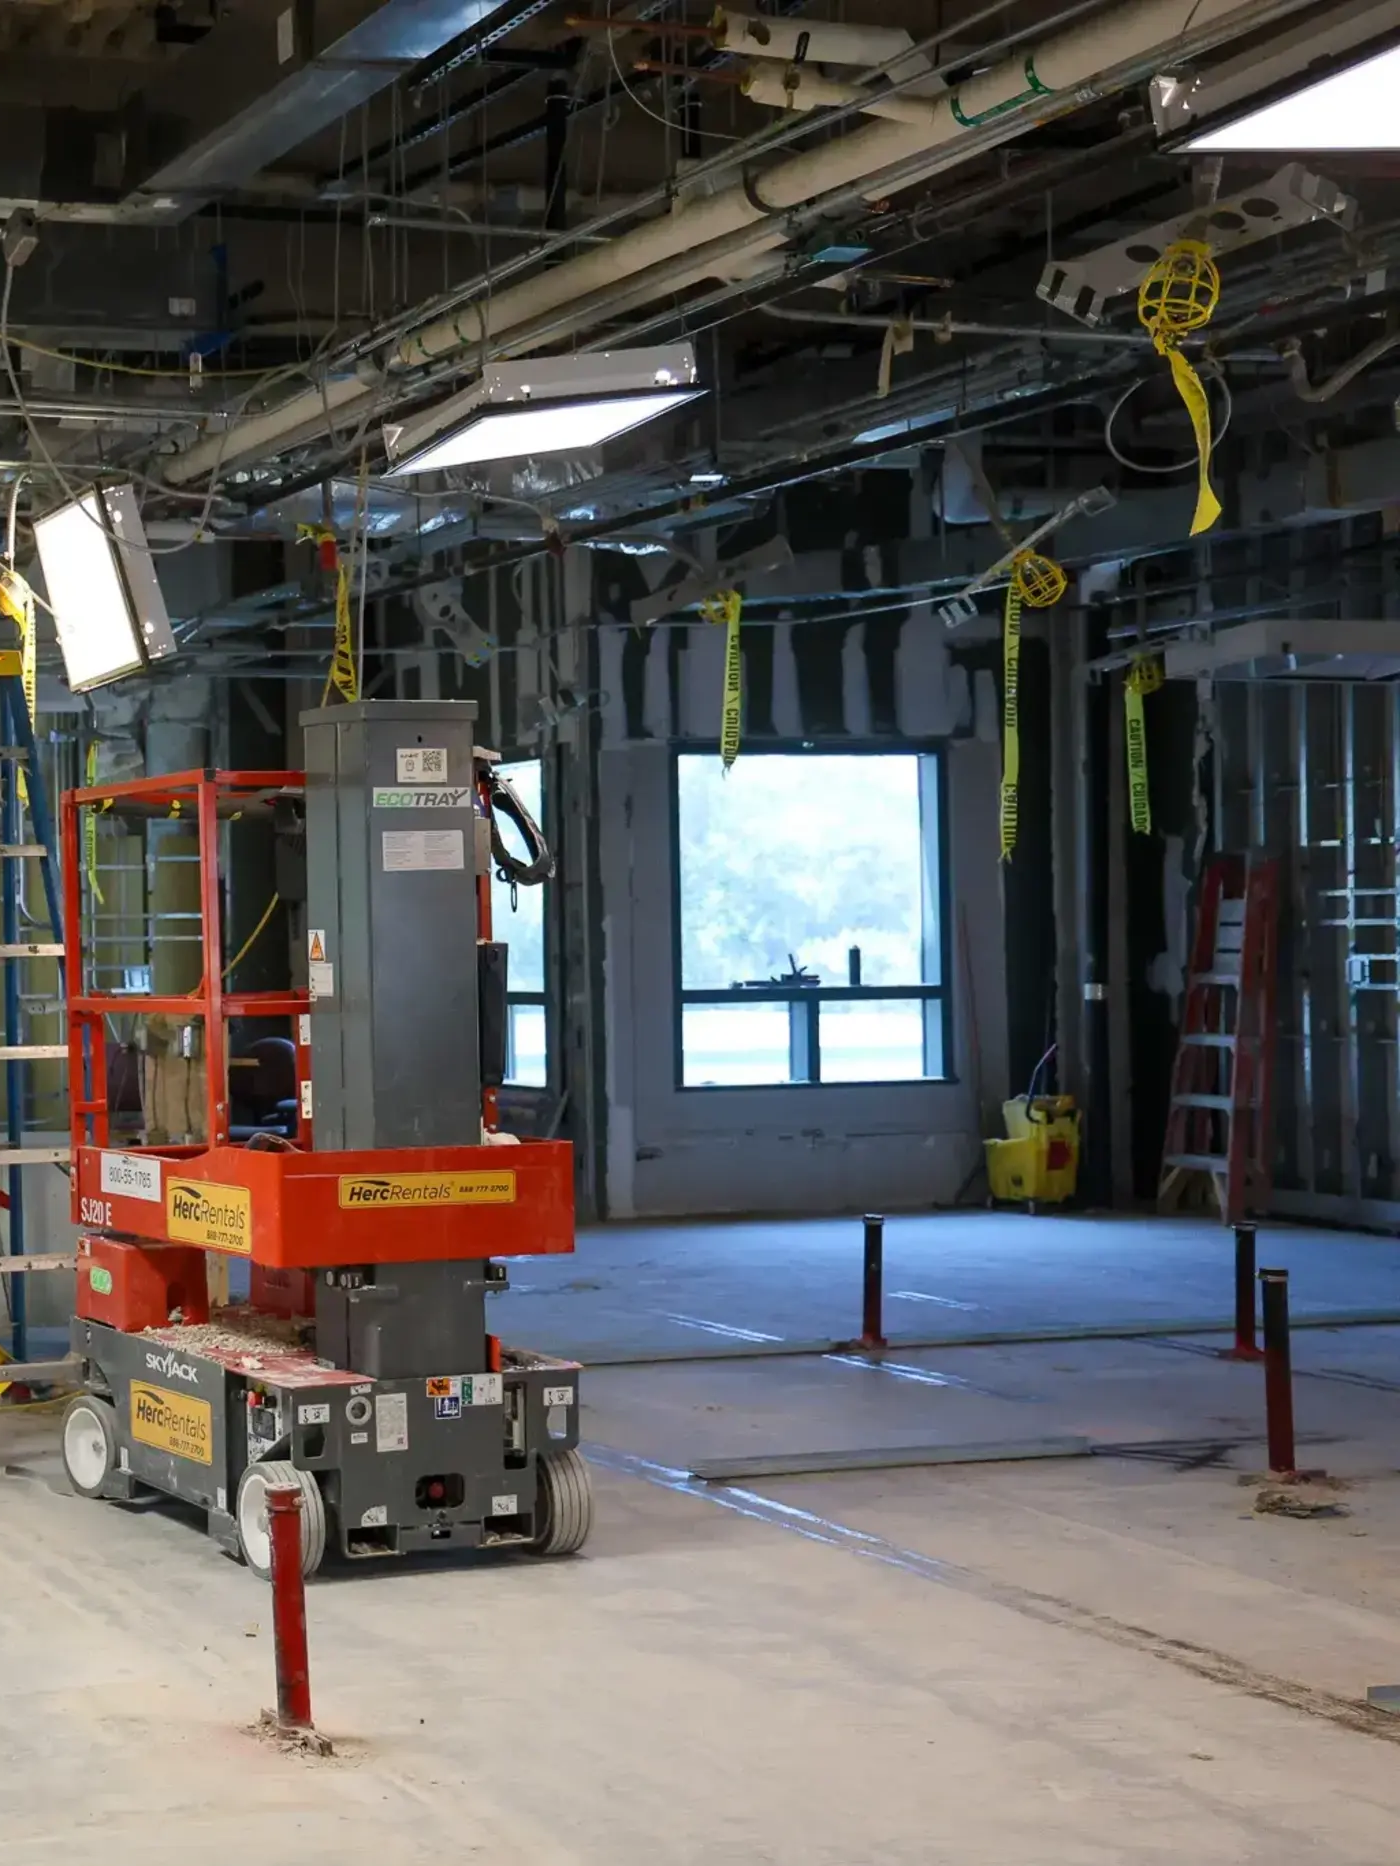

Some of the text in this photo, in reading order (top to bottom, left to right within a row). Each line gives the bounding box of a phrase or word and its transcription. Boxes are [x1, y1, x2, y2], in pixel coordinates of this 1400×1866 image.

[1128, 718, 1144, 769] CAUTION
[375, 789, 468, 806] ECOTRAY
[81, 1197, 113, 1227] SJ20 E
[145, 1351, 199, 1384] SKYJACK
